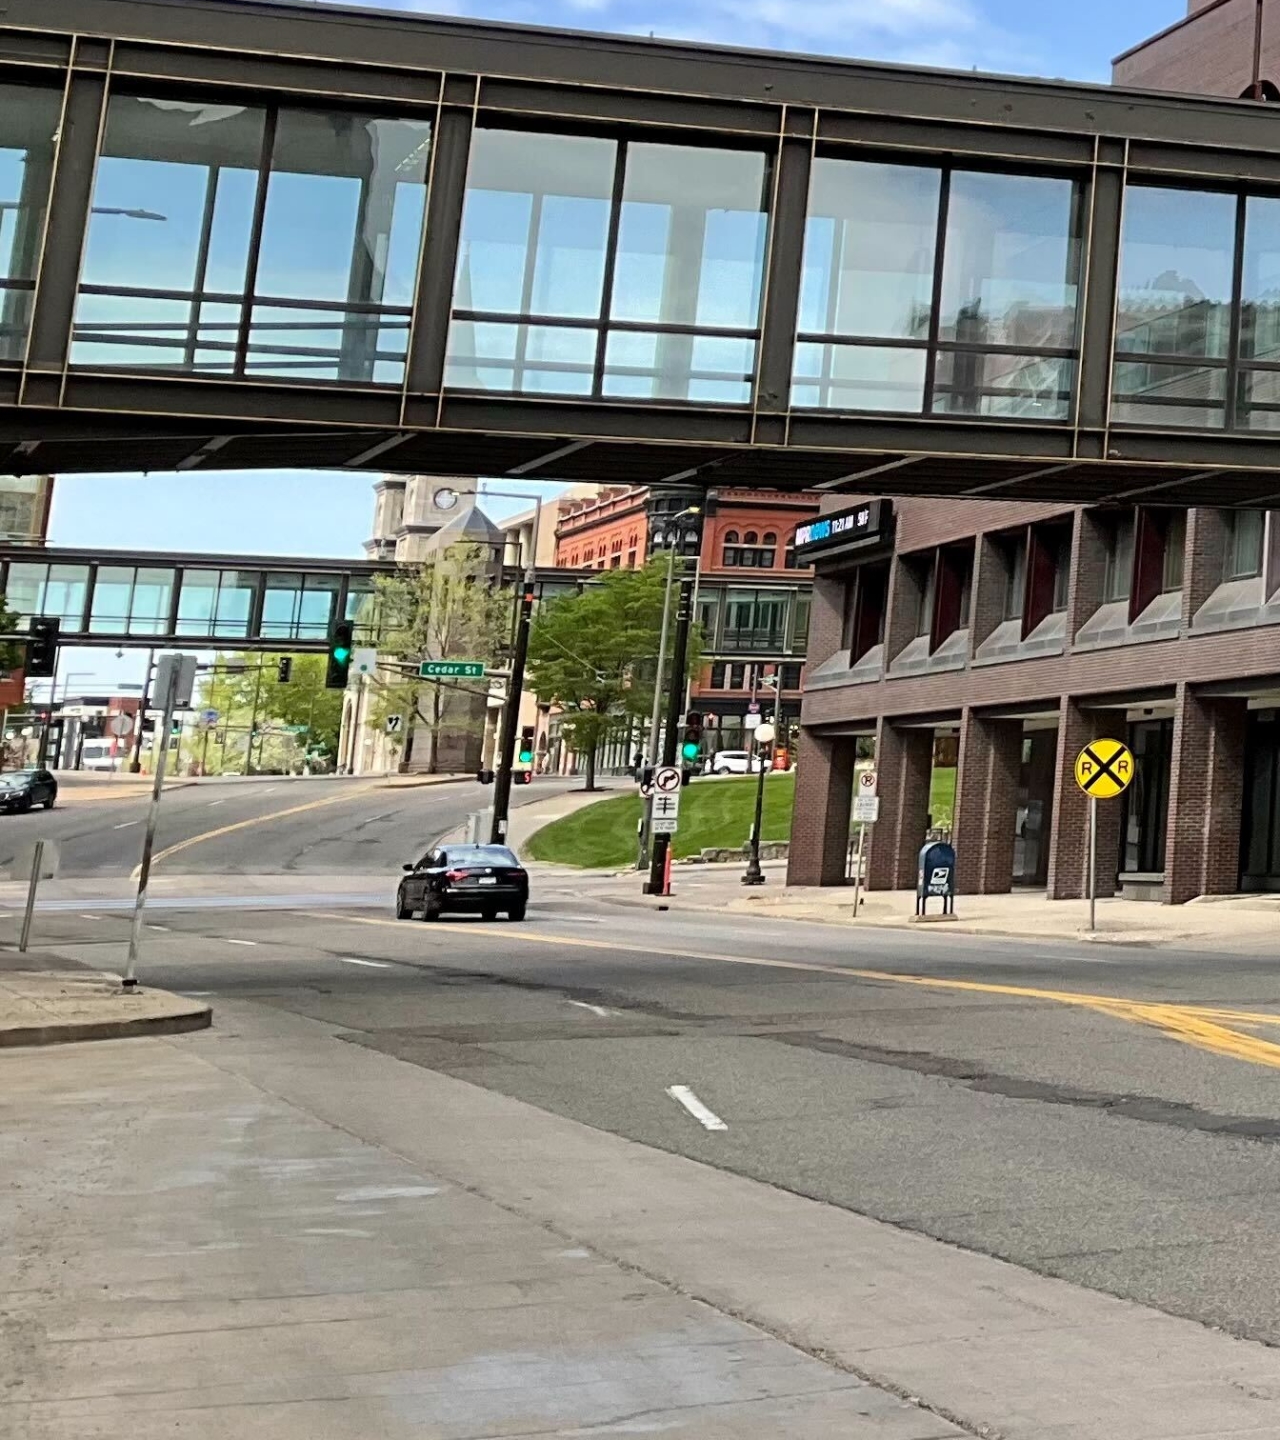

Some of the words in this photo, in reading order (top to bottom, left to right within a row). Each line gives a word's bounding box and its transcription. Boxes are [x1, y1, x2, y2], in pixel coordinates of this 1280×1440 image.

[427, 664, 460, 674] Cedar
[464, 665, 477, 675] St
[1081, 761, 1092, 775] R
[1117, 760, 1129, 774] R
